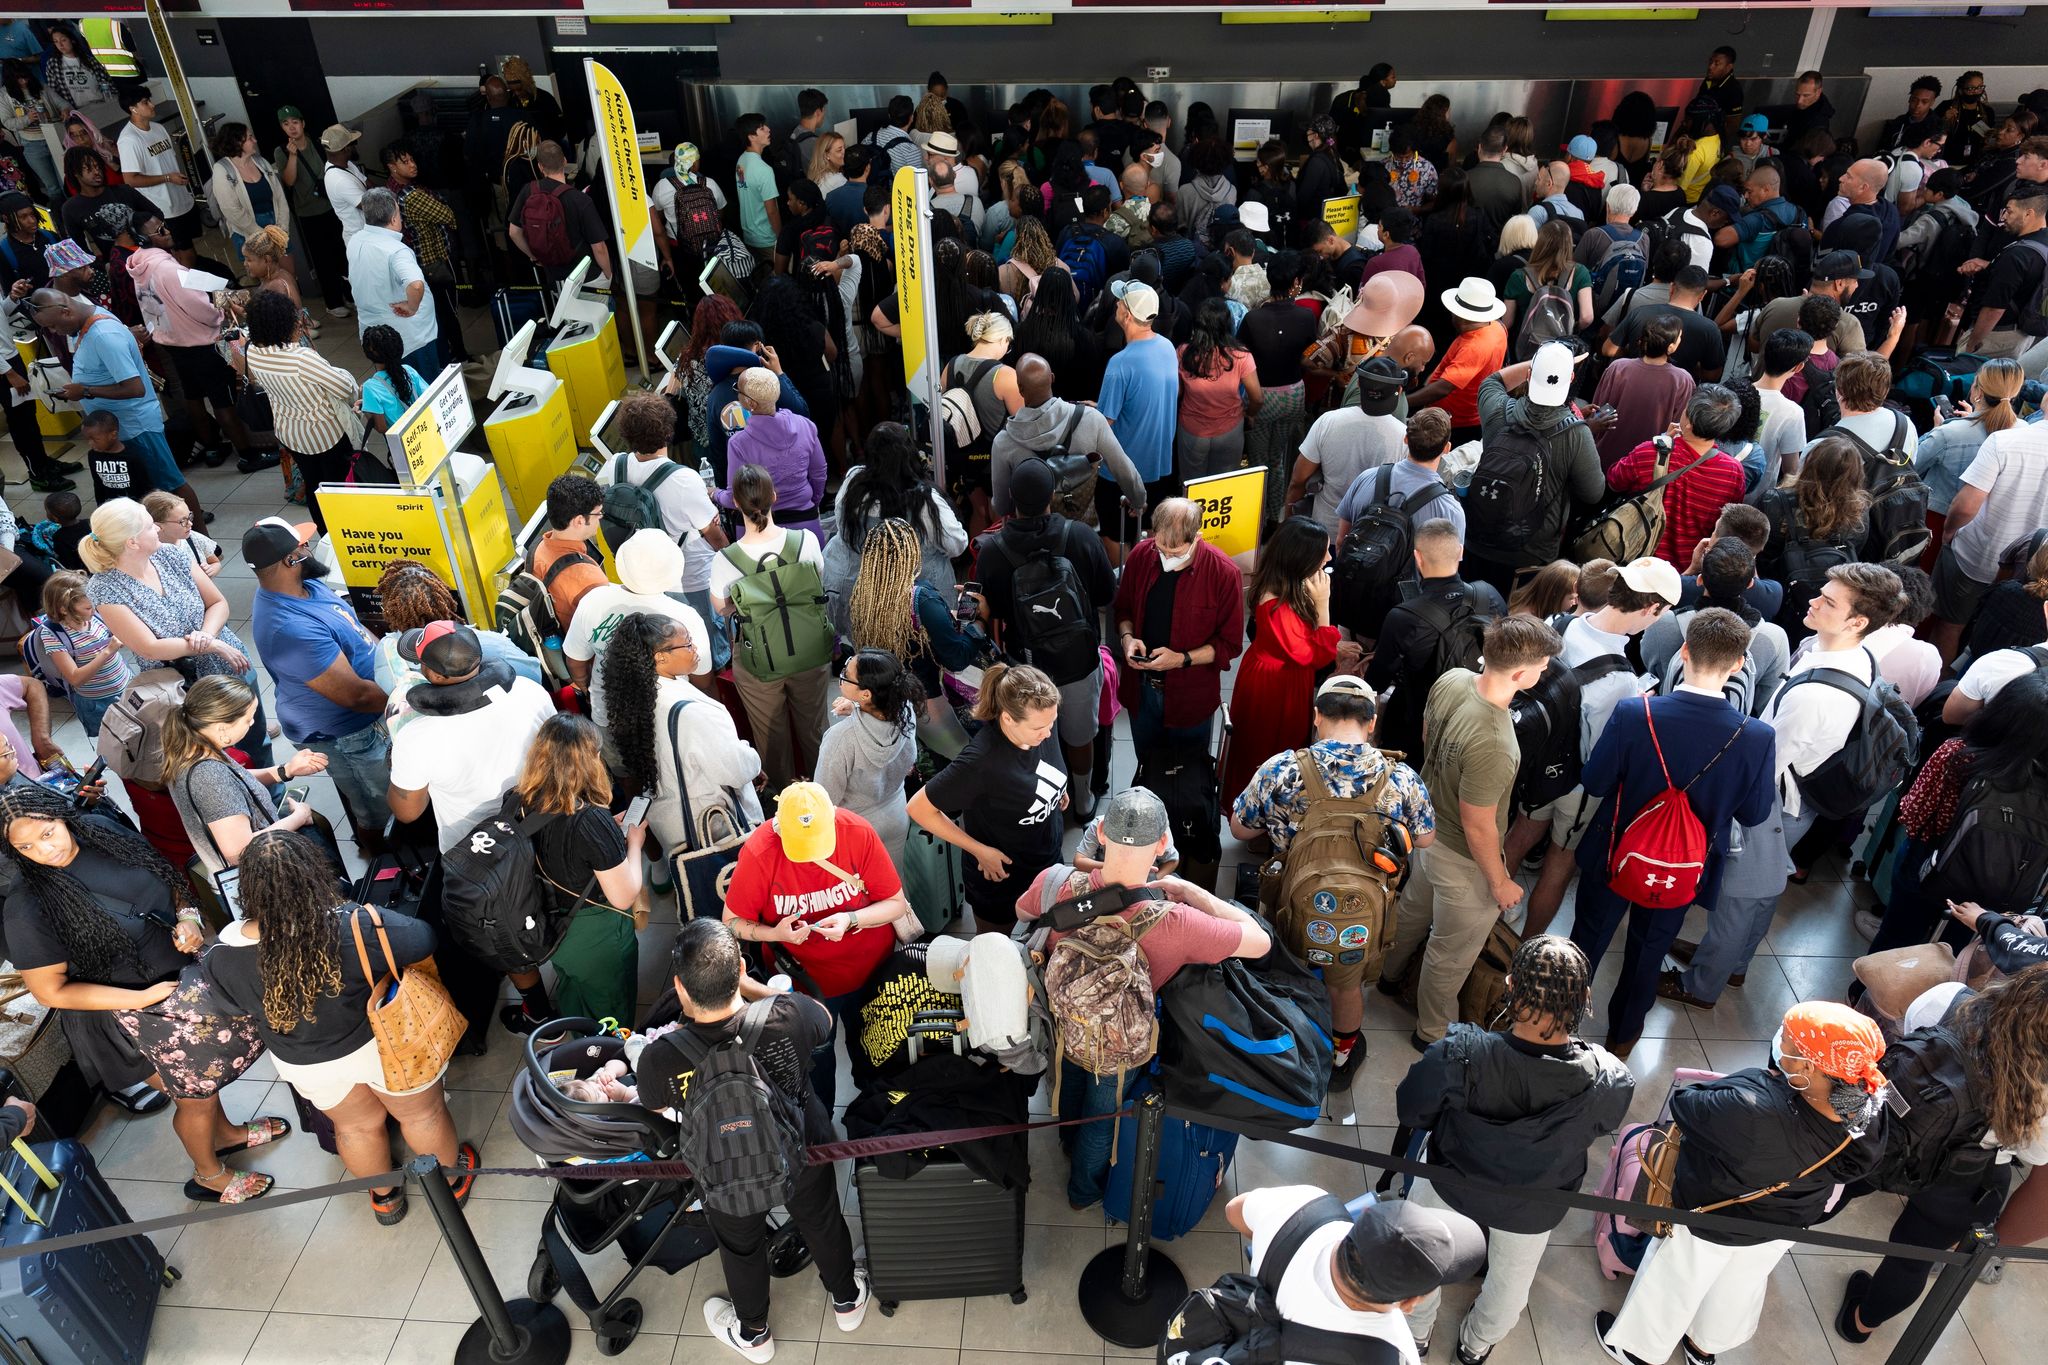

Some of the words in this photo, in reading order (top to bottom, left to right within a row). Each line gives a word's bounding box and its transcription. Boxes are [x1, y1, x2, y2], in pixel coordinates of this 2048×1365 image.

[604, 89, 615, 121] Check
[610, 123, 617, 134] in
[612, 134, 618, 146] en
[613, 92, 627, 135] Kiosk
[622, 138, 638, 202] Check-in
[614, 148, 626, 190] quiosco
[900, 242, 906, 257] de
[908, 233, 916, 280] Drop
[902, 257, 910, 314] equipaje
[439, 396, 448, 408] Get
[448, 383, 459, 399] Your
[441, 394, 464, 420] Boarding
[444, 416, 457, 432] Pass
[406, 420, 428, 446] Self-Tag
[408, 442, 423, 458] Your
[96, 461, 128, 473] DAD'S
[412, 455, 424, 470] Bag
[1194, 496, 1233, 515] Bag
[1201, 515, 1231, 530] rop
[342, 528, 375, 539] Have
[378, 531, 403, 542] you
[347, 544, 376, 556] paid
[379, 545, 398, 554] for
[400, 547, 432, 557] your
[774, 882, 867, 915] WASHINGTO
